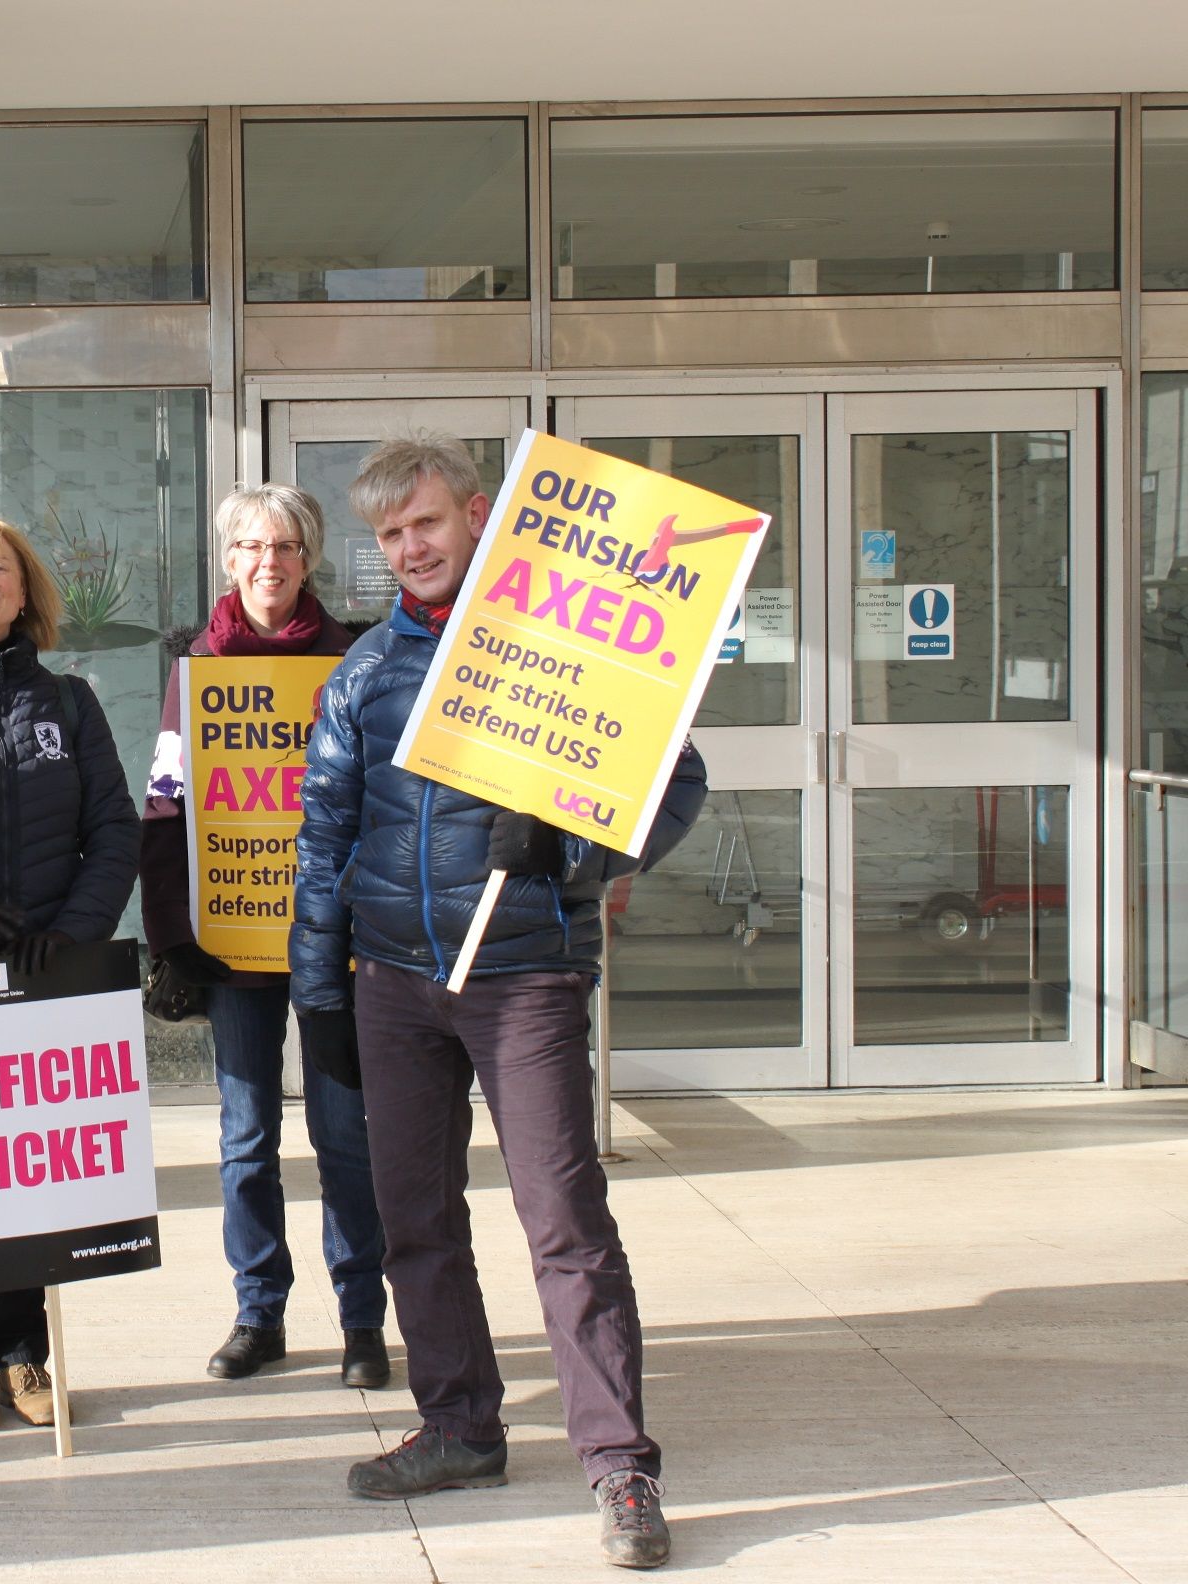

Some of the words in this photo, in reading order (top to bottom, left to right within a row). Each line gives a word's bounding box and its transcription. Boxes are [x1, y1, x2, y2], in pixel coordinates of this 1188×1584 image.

[531, 469, 616, 523] OUR
[512, 506, 701, 601] PENSION
[484, 557, 676, 668] AXED.
[468, 626, 584, 685] Support
[911, 641, 929, 649] Keep
[201, 685, 275, 713] OUR
[455, 664, 506, 694] our
[507, 683, 588, 726] strike
[594, 711, 622, 739] to
[441, 695, 541, 747] defend
[545, 731, 602, 770] USS
[420, 757, 513, 796] www.ucu.org.uk/strikeforuss
[208, 868, 246, 884] our
[208, 894, 288, 917] defend
[72, 1236, 152, 1259] www.ucu.org.uk
